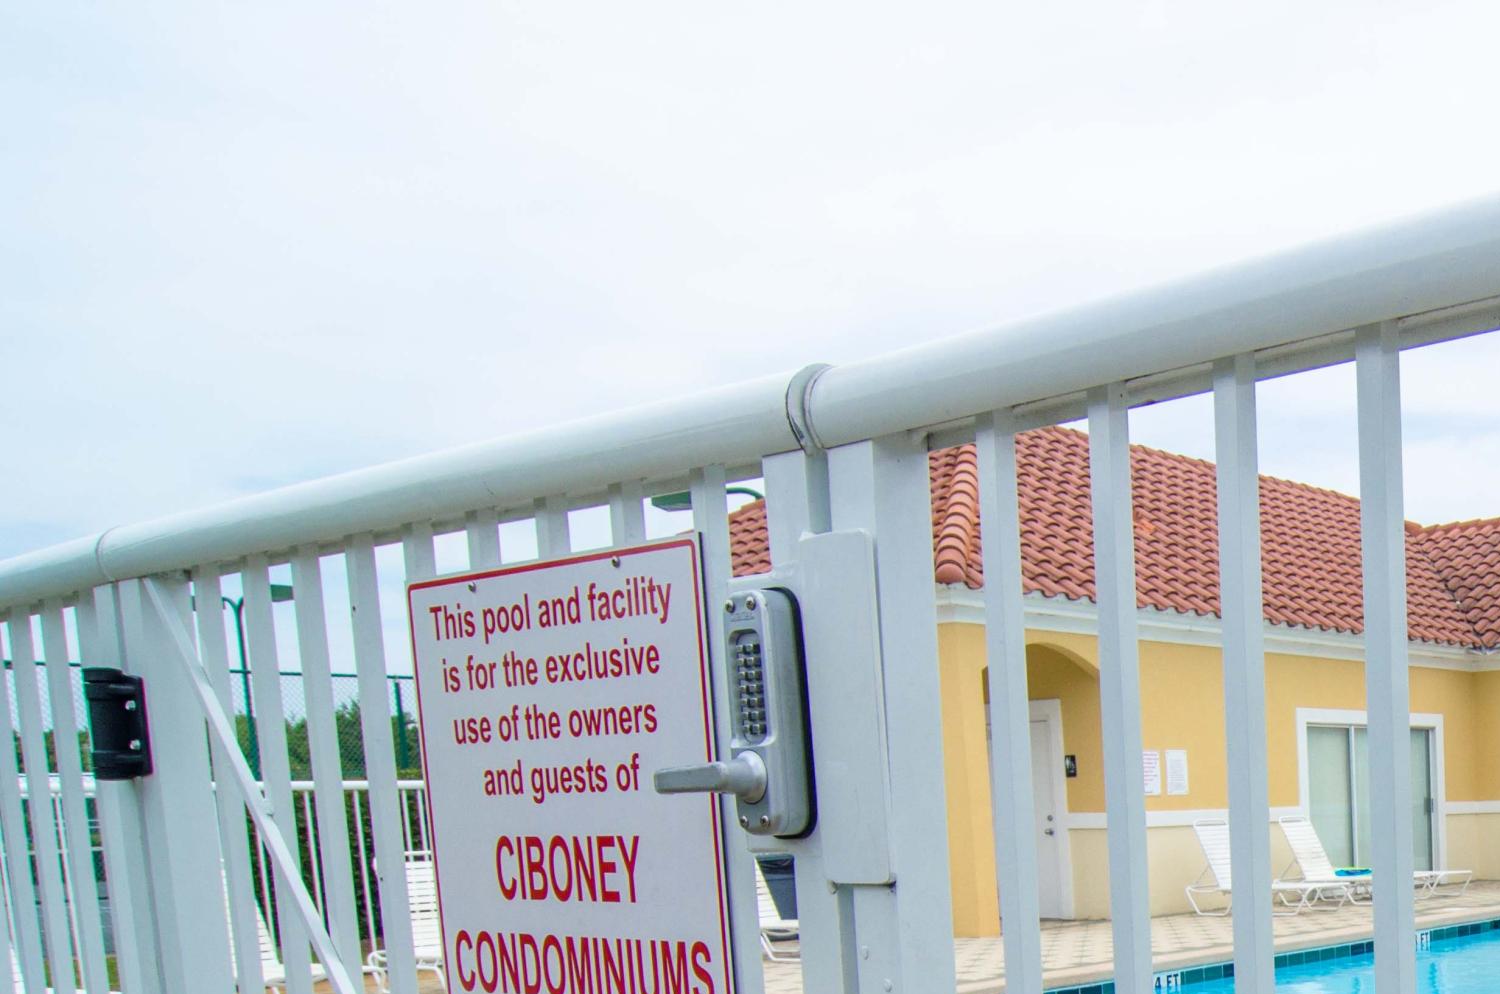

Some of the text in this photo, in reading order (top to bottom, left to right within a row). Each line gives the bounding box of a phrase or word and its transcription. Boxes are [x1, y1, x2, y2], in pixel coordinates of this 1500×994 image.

[429, 575, 672, 645] This pool and facility
[442, 637, 661, 693] is for the exclusive
[453, 702, 659, 745] use of the owners
[484, 752, 641, 805] and guests of
[495, 834, 641, 904] CIBONEY
[1166, 973, 1179, 989] FT
